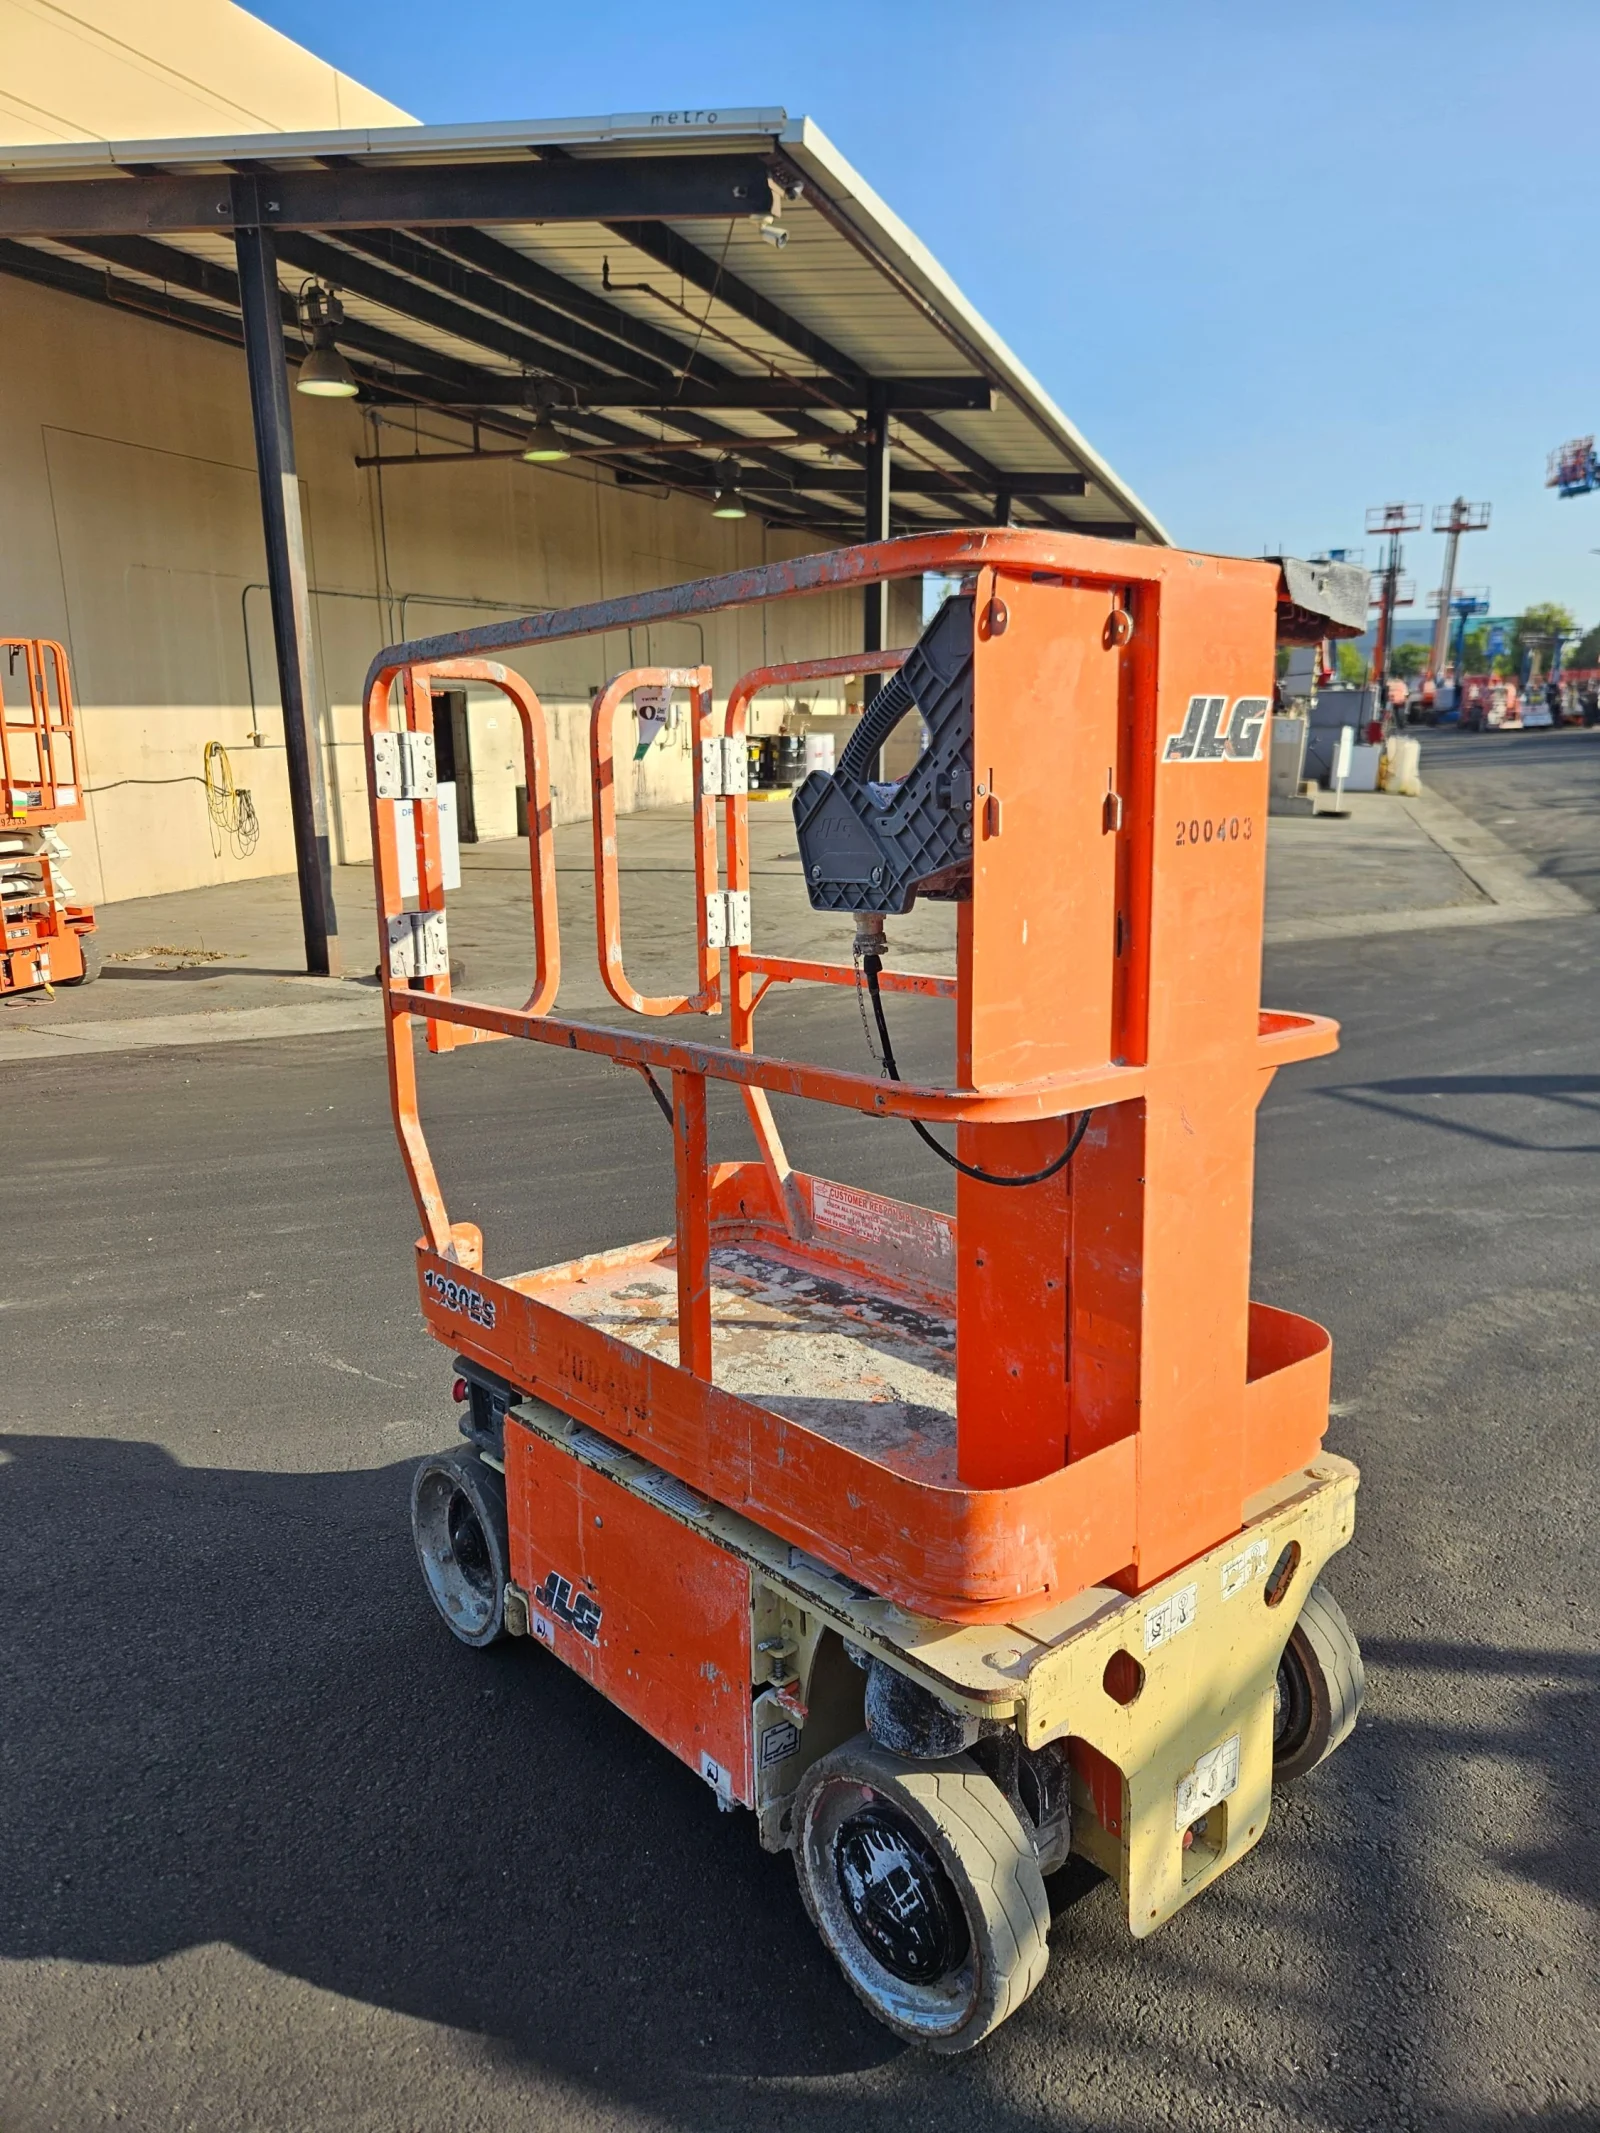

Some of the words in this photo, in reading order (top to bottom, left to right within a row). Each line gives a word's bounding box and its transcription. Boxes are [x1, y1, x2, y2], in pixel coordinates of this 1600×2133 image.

[651, 111, 718, 126] metro
[1161, 695, 1271, 763] JLG
[816, 817, 855, 840] JLG
[1175, 817, 1253, 846] 200403
[830, 1188, 868, 1209] CUSTOMER
[534, 1570, 603, 1646] JLG
